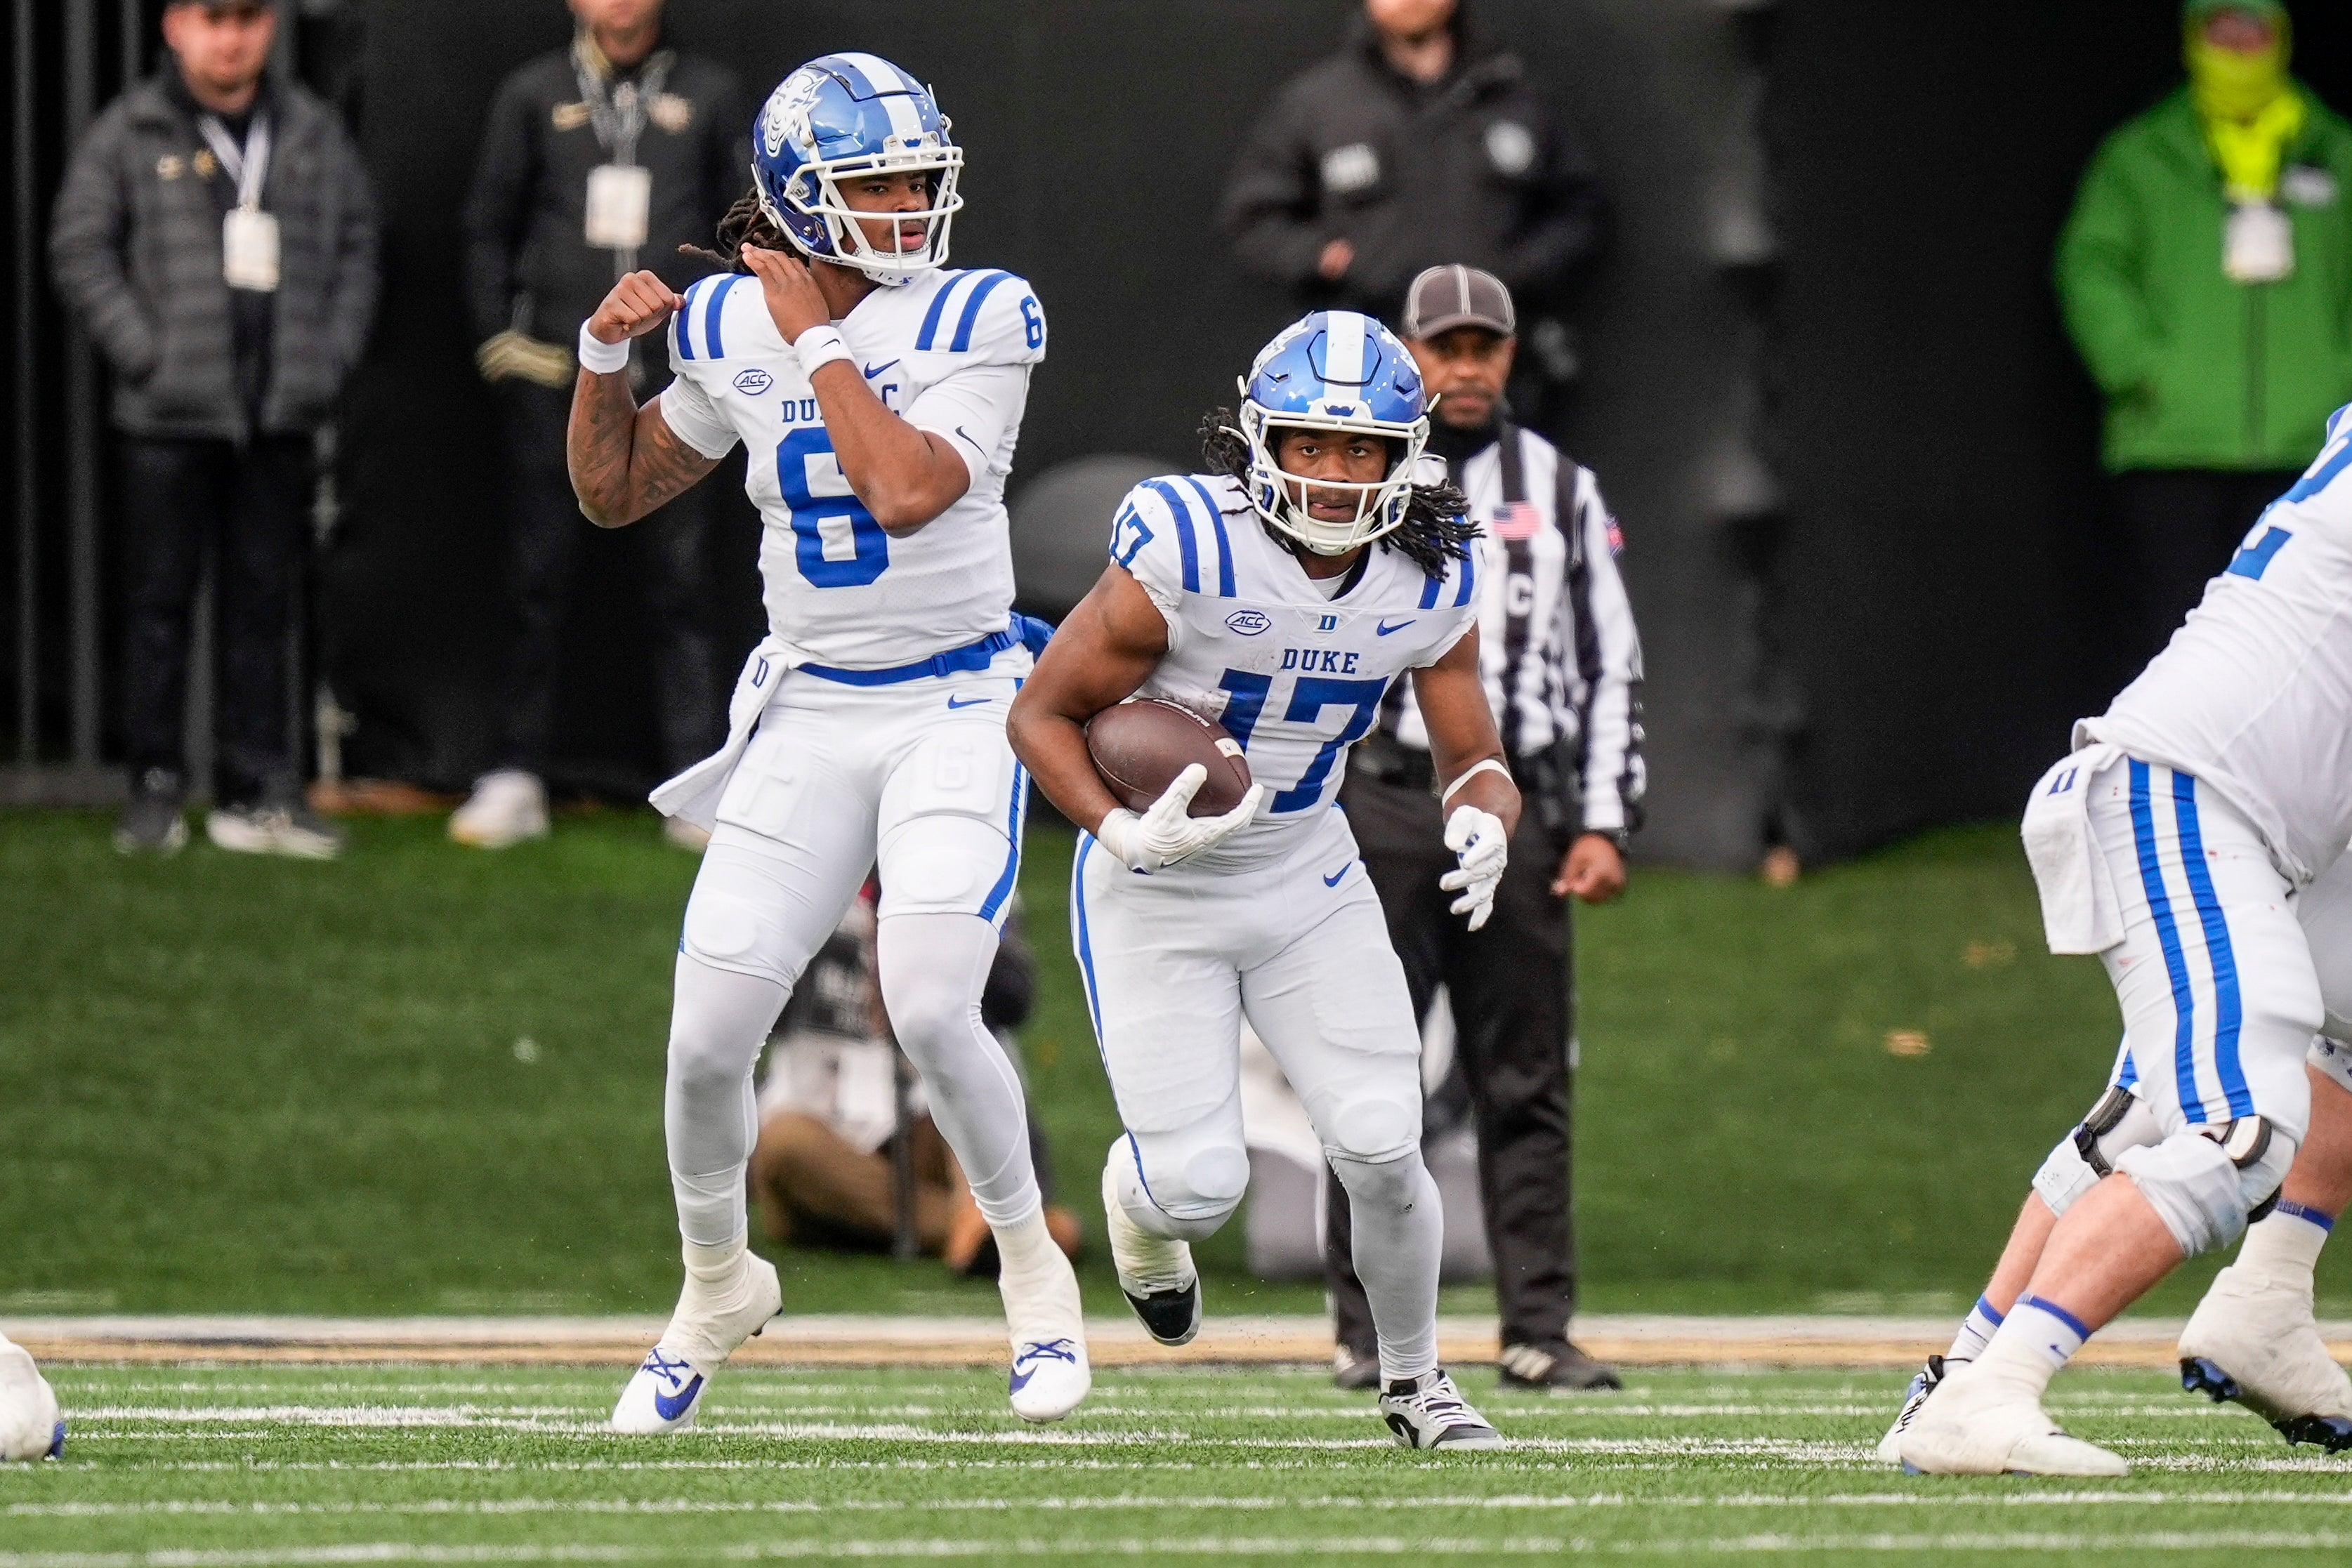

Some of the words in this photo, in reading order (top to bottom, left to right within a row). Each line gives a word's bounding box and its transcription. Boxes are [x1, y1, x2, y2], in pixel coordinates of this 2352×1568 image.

[1020, 295, 1043, 350] 6
[739, 374, 767, 386] ACC
[776, 426, 890, 588] 6
[1109, 499, 1155, 569] 17
[1506, 572, 1533, 617] C
[1231, 616, 1266, 627] ACC
[1317, 614, 1338, 631] D
[1280, 647, 1360, 675] DUKE
[1218, 668, 1389, 813] 17
